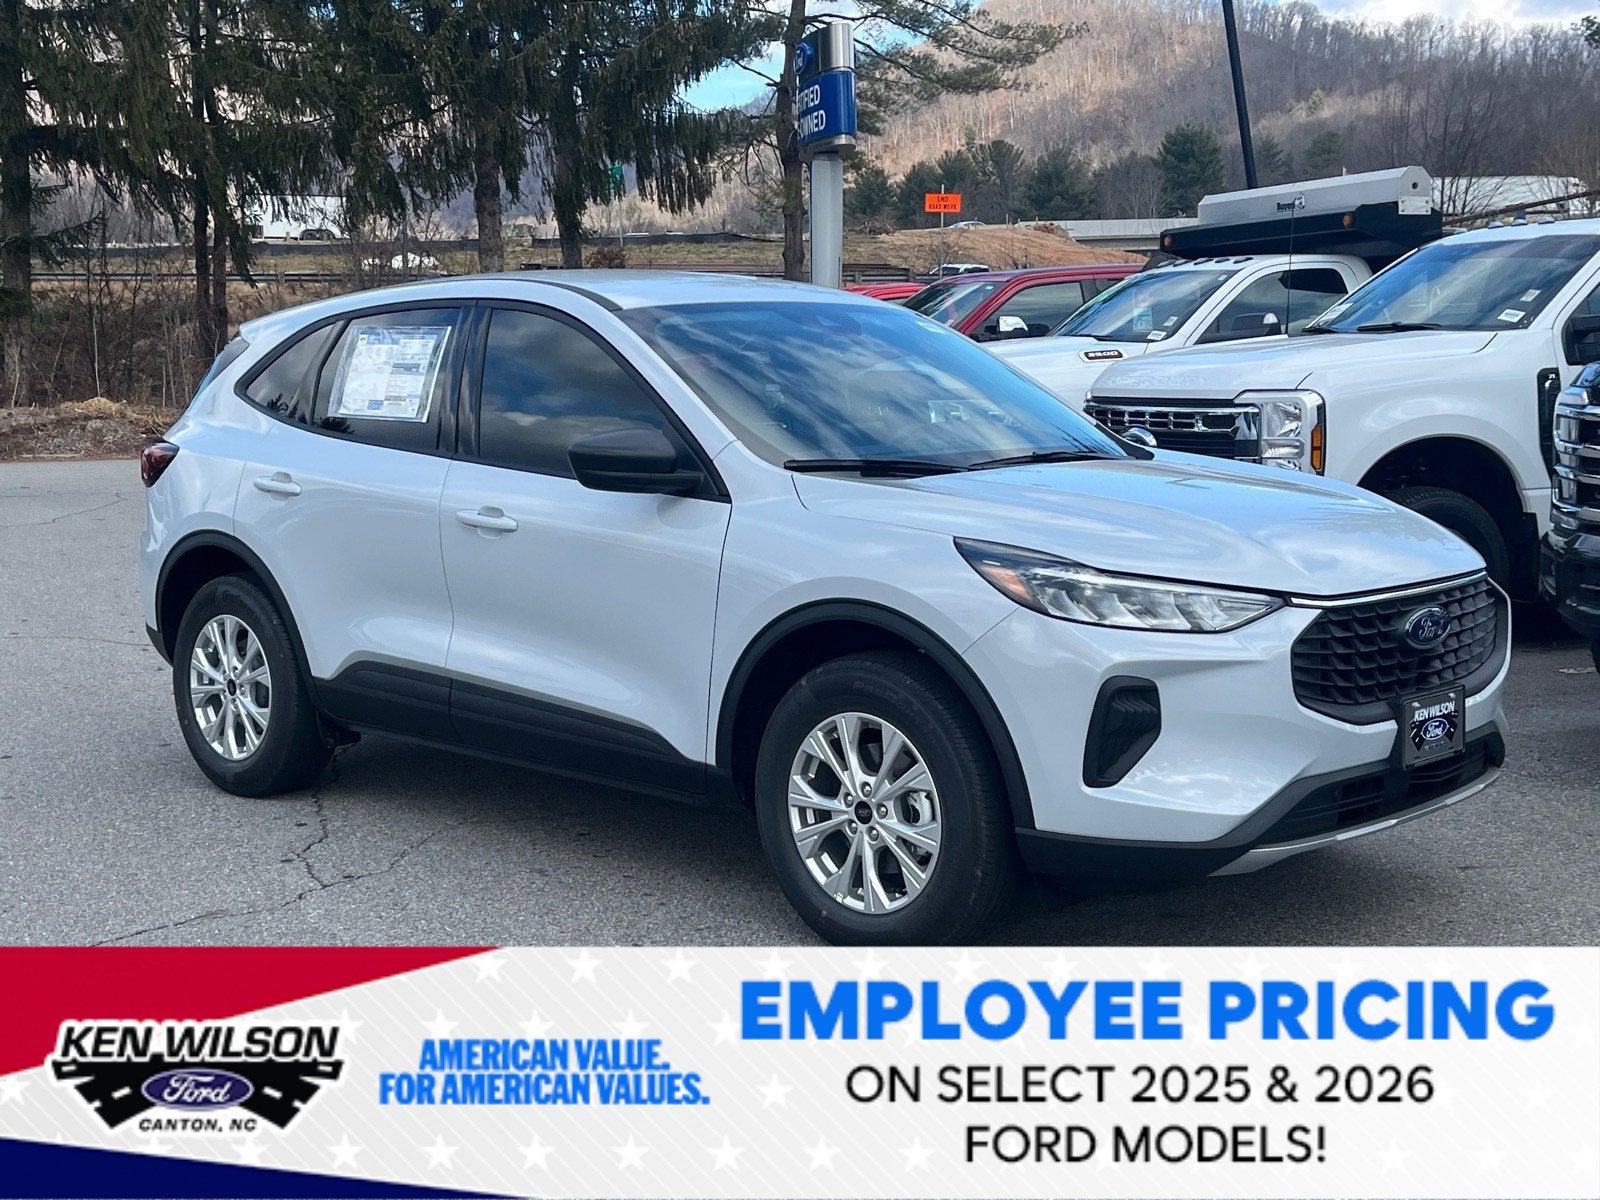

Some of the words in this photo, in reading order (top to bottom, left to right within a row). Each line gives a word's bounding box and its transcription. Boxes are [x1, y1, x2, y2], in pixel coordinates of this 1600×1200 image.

[1413, 707, 1429, 722] KEN
[1429, 701, 1455, 718] WILSON
[1426, 721, 1444, 738] Ford
